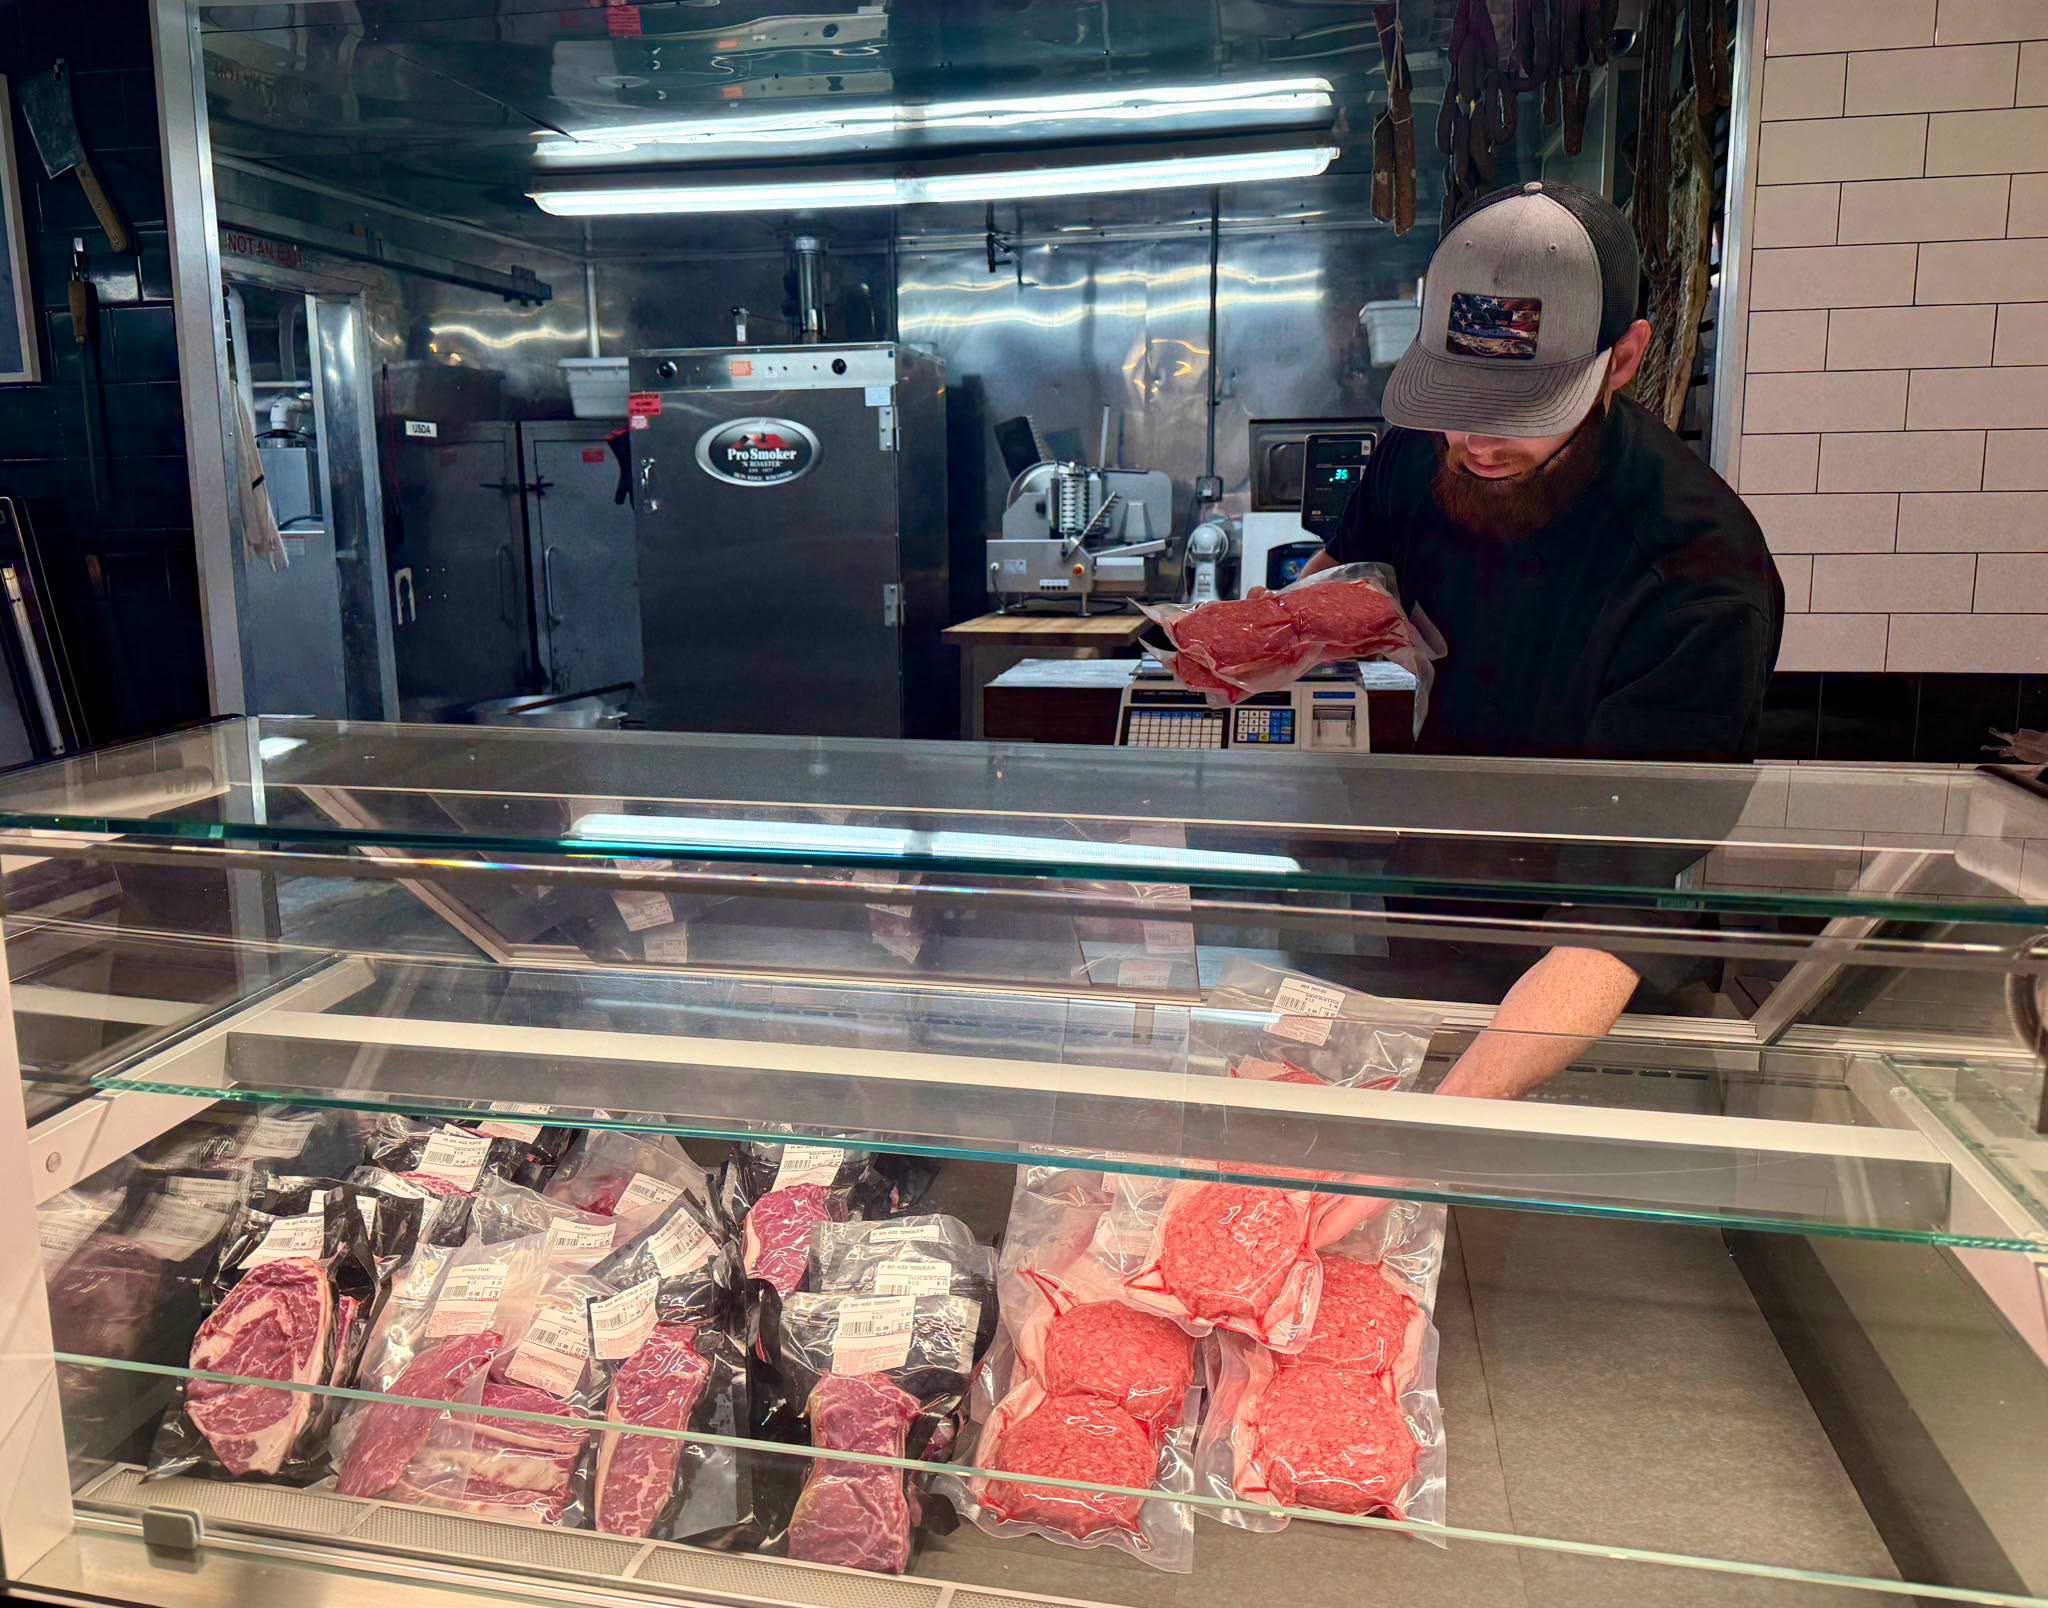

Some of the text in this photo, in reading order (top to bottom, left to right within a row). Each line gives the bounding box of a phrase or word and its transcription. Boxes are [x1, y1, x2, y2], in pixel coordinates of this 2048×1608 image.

[226, 233, 306, 267] NOT AN EX
[412, 424, 431, 434] USDA
[727, 448, 797, 460] Pro Smoker
